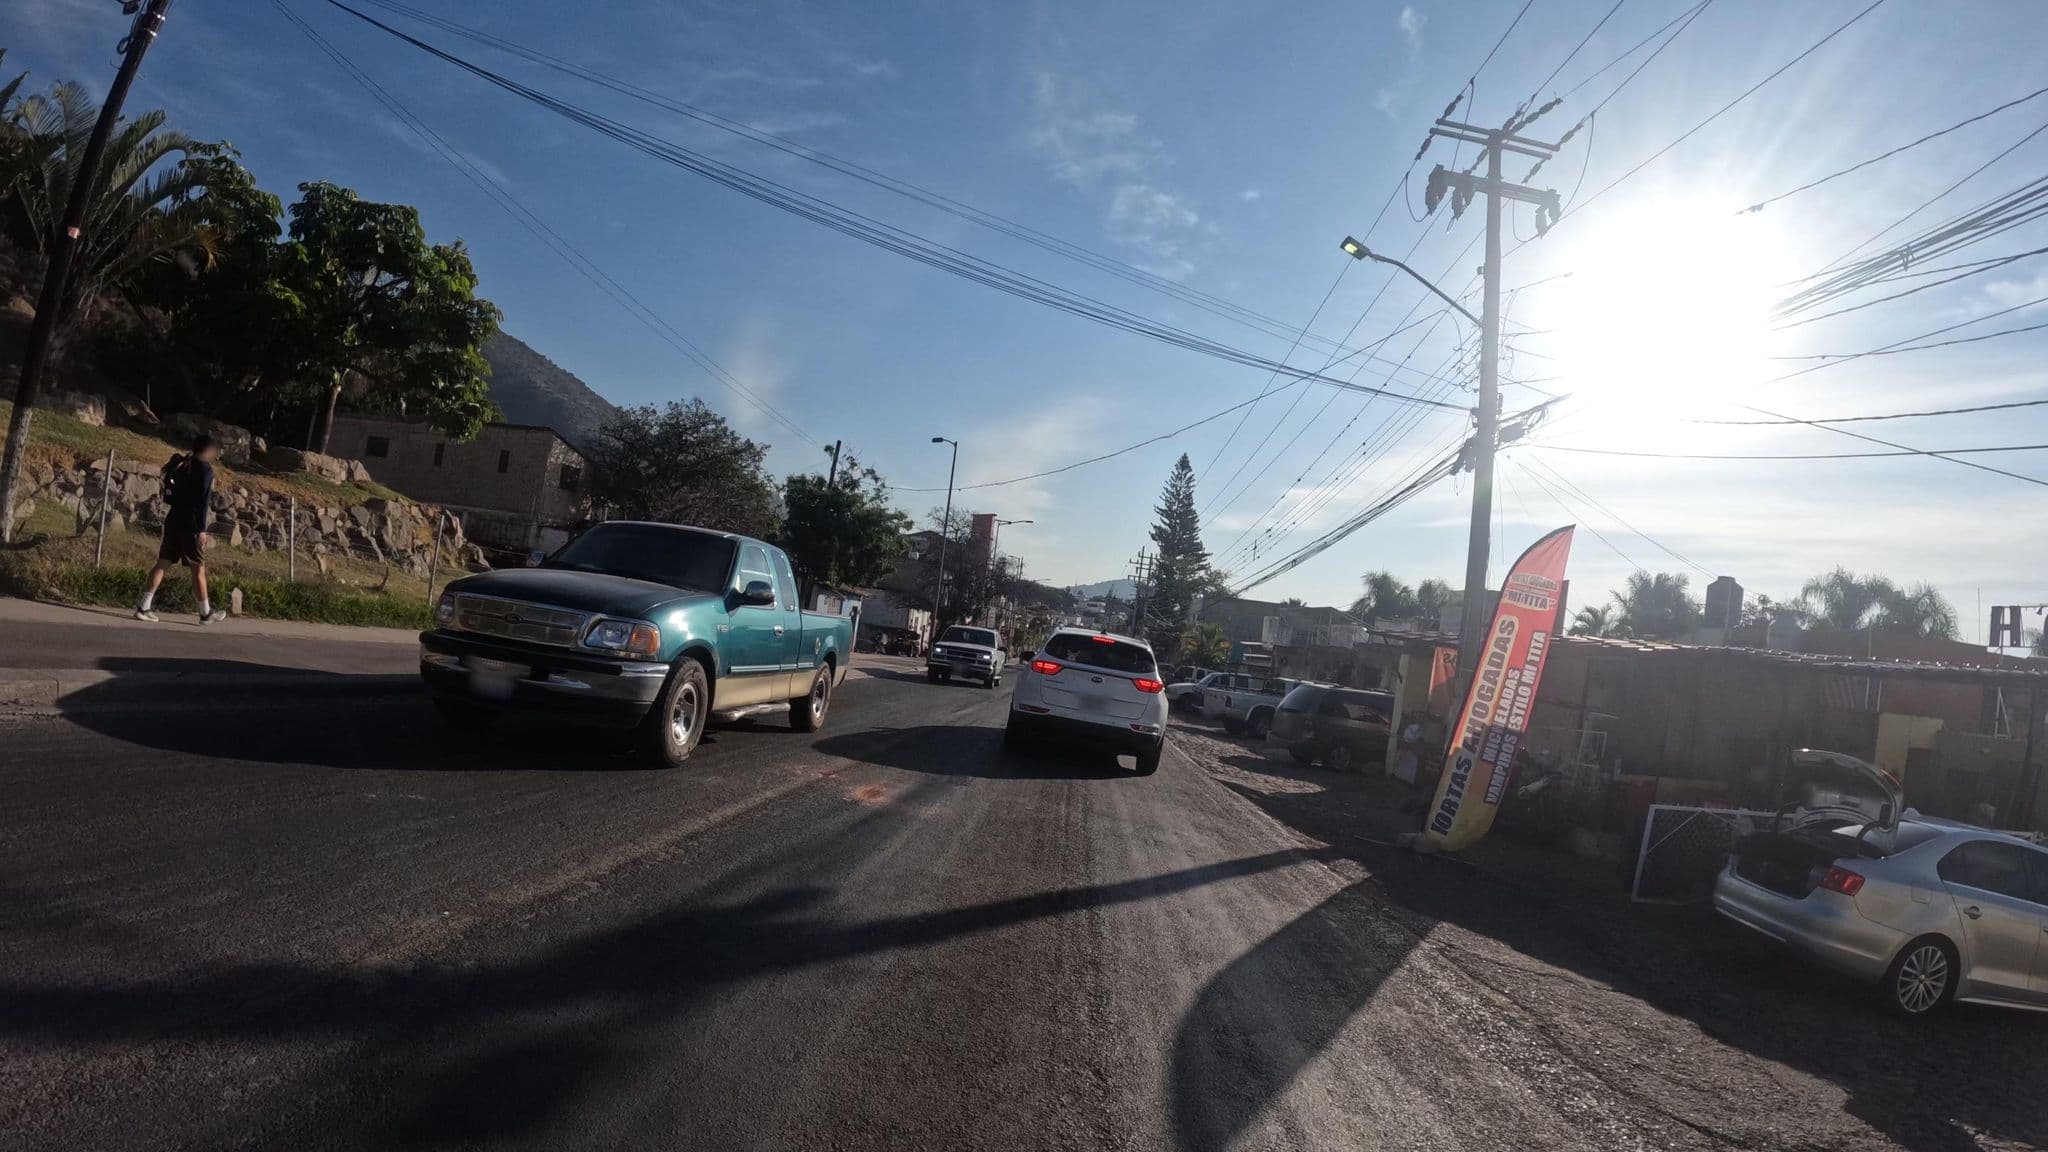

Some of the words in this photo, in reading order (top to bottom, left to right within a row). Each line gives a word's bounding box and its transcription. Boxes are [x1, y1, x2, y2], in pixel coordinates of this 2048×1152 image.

[1522, 662, 1536, 685] MI
[1527, 631, 1546, 662] TITA
[1430, 756, 1473, 836] TORTAS
[1462, 619, 1516, 752] AHOGADAS
[1483, 668, 1520, 762] MICHELADAS
[1508, 685, 1532, 731] ESTILO
[1486, 735, 1517, 804] VAMPIROS
